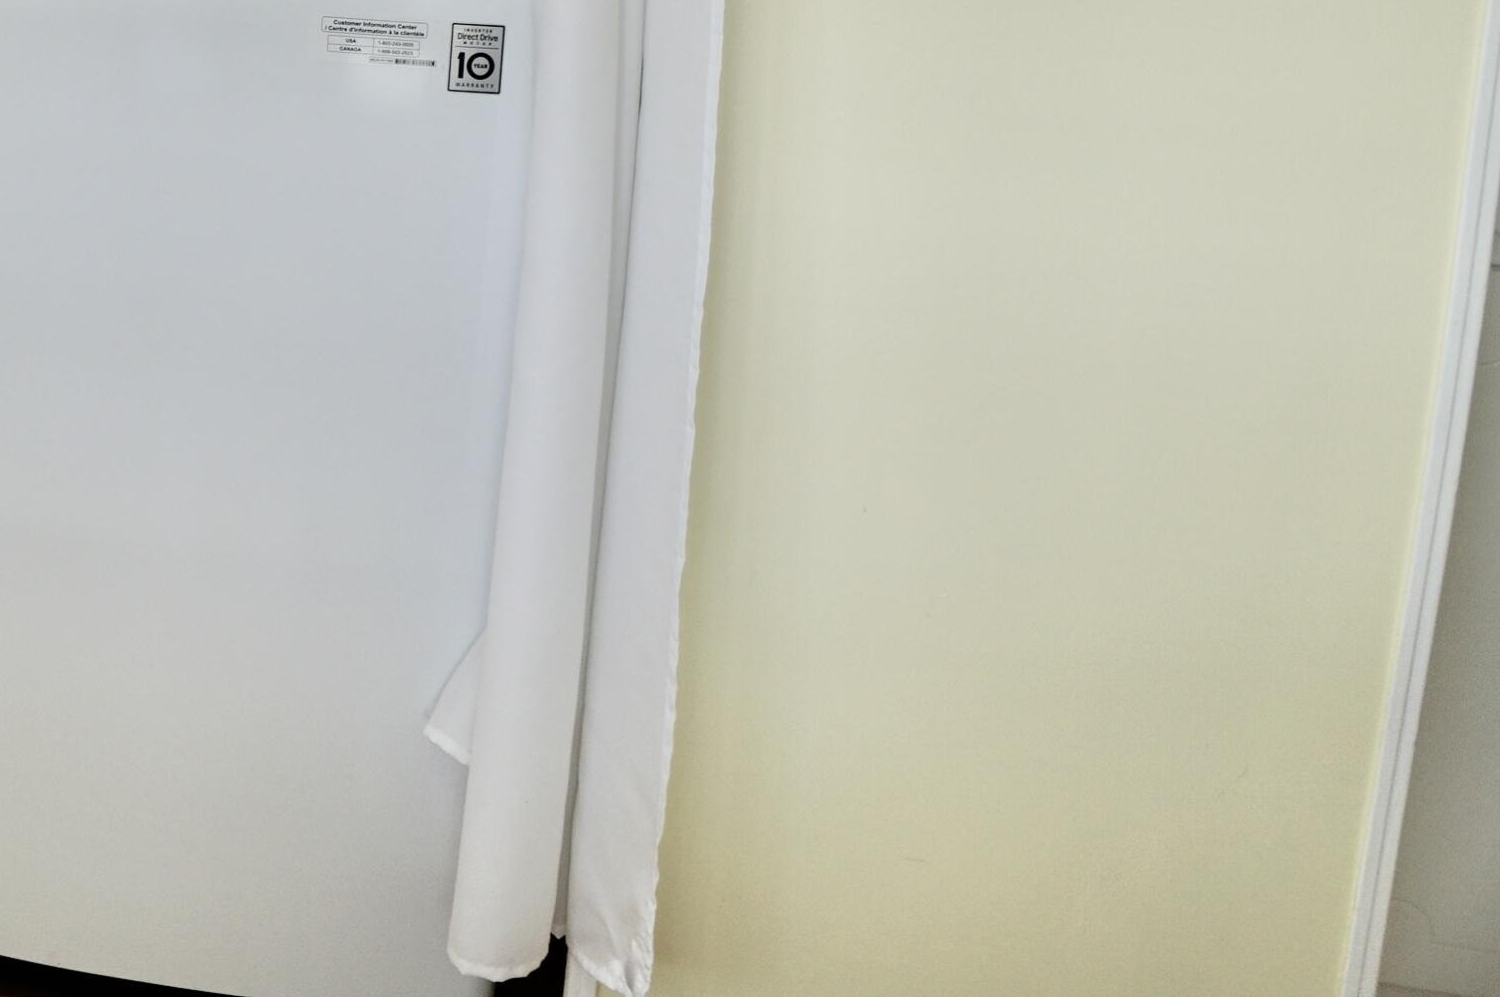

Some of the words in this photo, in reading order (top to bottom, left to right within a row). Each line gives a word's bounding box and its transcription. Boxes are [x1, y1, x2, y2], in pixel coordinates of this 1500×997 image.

[333, 19, 362, 27] Customer
[363, 21, 397, 29] Information
[348, 26, 388, 35] d'information
[457, 32, 479, 41] Direct
[480, 33, 499, 42] Drive
[457, 51, 496, 81] 10
